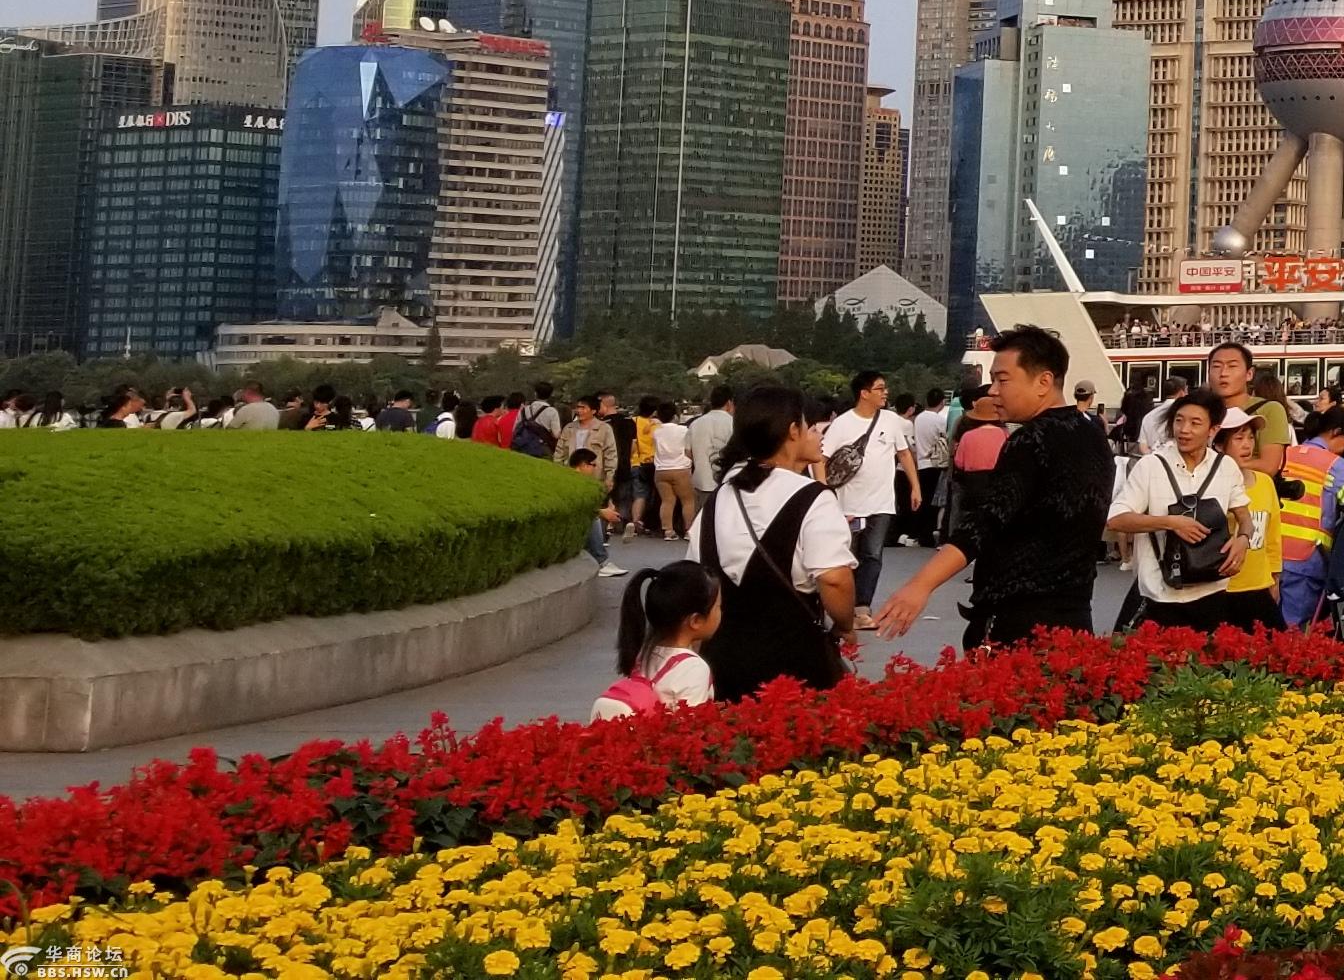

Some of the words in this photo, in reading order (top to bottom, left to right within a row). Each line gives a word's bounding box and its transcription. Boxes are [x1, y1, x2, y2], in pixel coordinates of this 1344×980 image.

[165, 111, 191, 126] DBS
[1186, 266, 1236, 277] 中国平安
